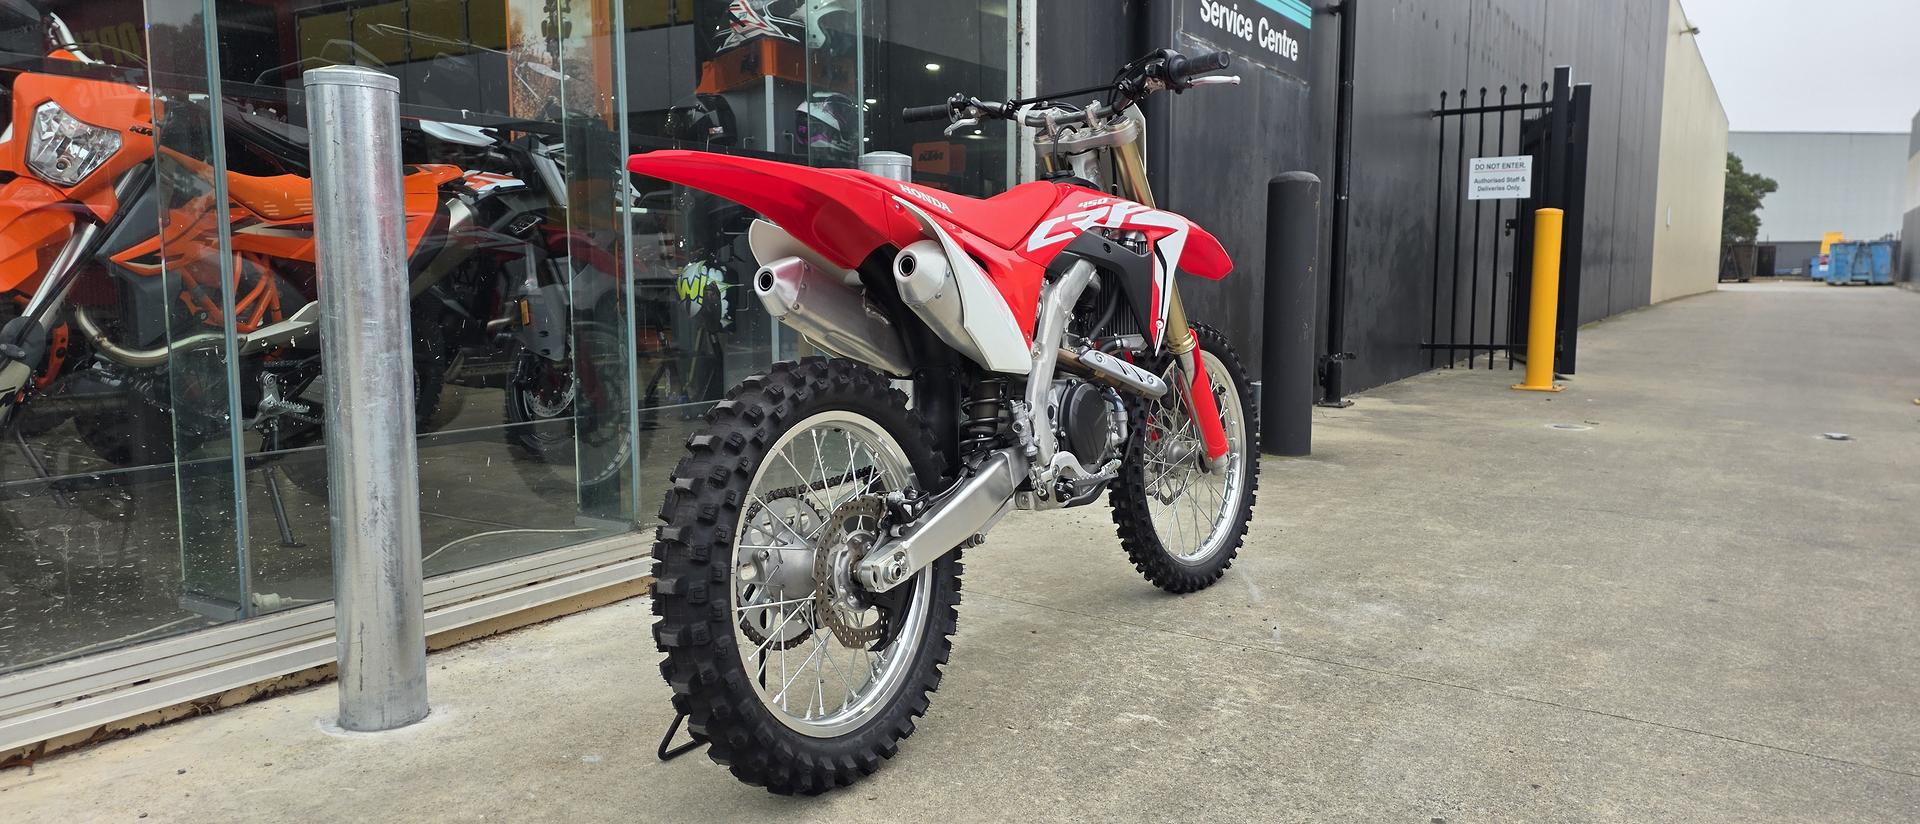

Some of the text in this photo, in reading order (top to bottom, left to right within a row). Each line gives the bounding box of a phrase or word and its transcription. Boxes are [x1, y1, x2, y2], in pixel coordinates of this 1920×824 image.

[1200, 0, 1298, 61] Service Centre
[919, 151, 944, 161] KTM
[897, 183, 953, 213] HONDA
[1027, 201, 1148, 252] CRF
